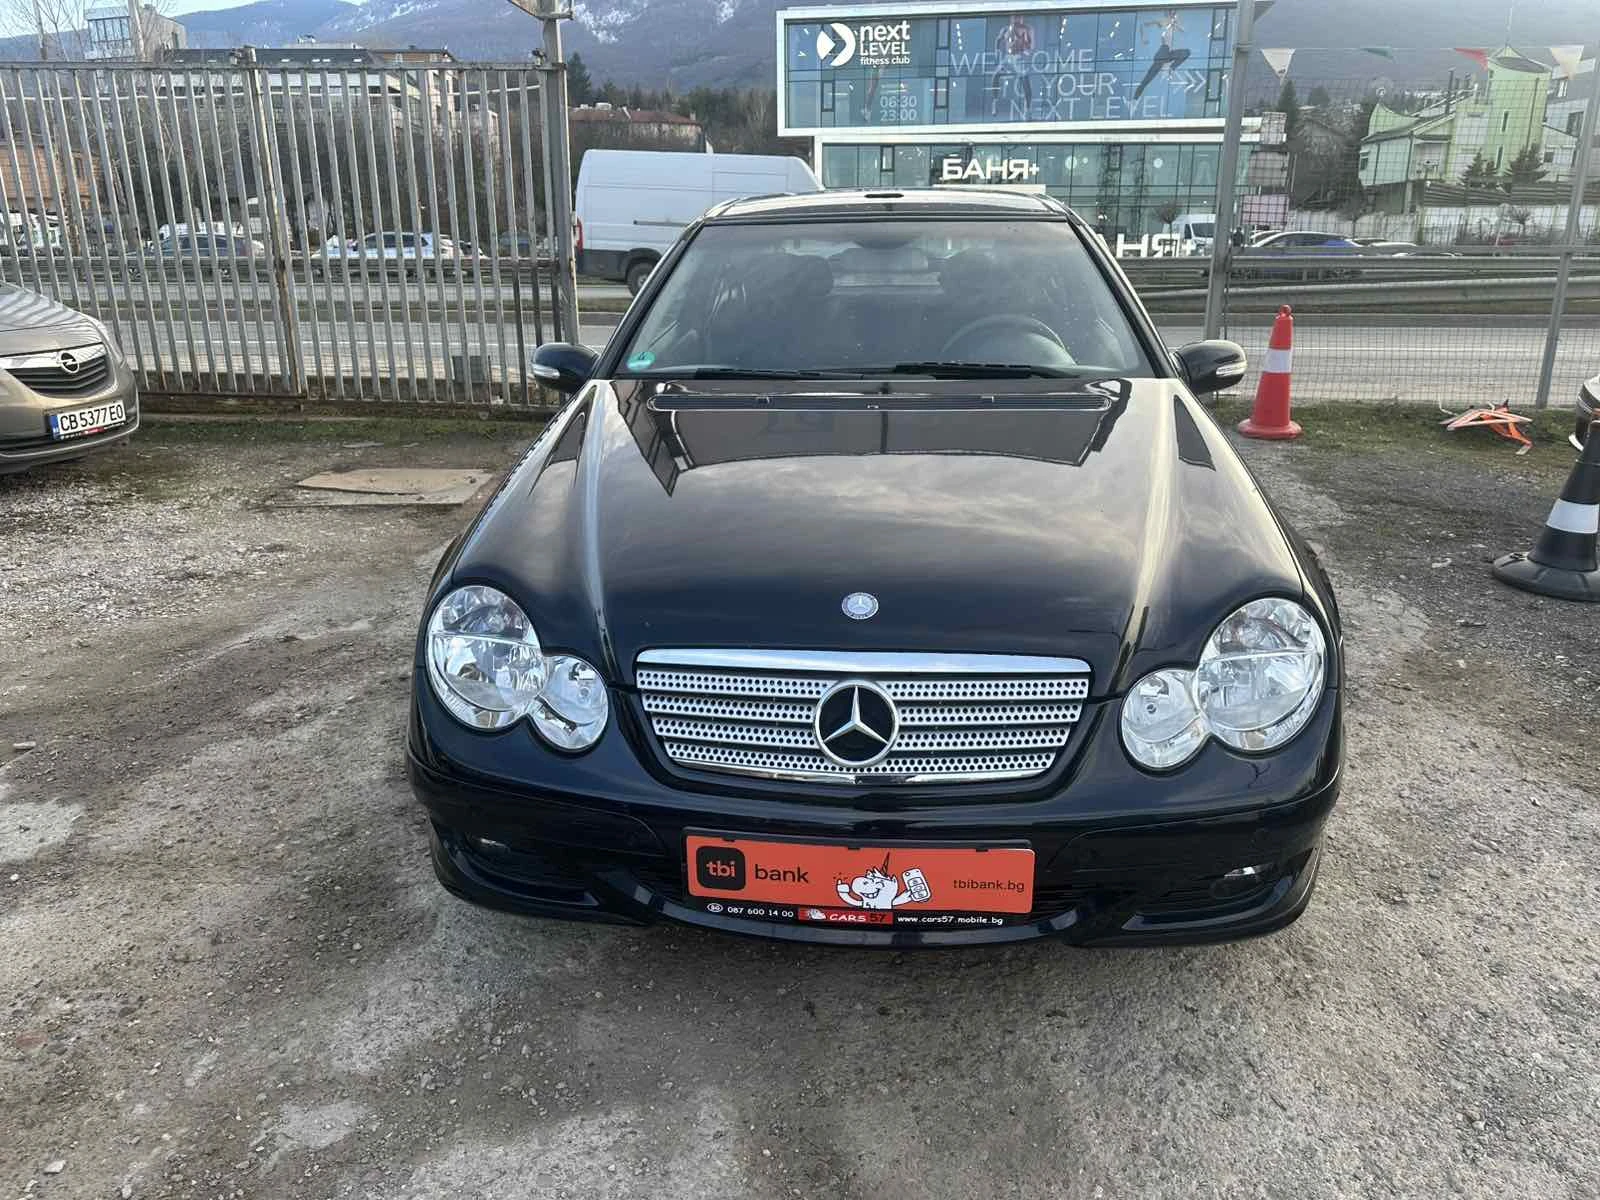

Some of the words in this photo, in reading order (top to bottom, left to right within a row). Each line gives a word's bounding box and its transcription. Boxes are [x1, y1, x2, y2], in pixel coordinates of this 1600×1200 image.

[860, 20, 911, 42] next
[860, 40, 911, 56] LEVEL
[860, 56, 890, 65] fitness
[891, 55, 911, 65] club
[1041, 72, 1115, 97] YOUR
[1009, 97, 1081, 121] NEXT
[1090, 95, 1174, 119] LEVEL
[706, 860, 736, 878] tbi
[754, 863, 809, 884] bank
[953, 878, 1025, 893] tbibank.bg
[727, 906, 743, 914] 087
[747, 908, 765, 916] 600
[768, 909, 778, 917] 14
[781, 910, 794, 918] 00
[829, 913, 866, 922] CARS
